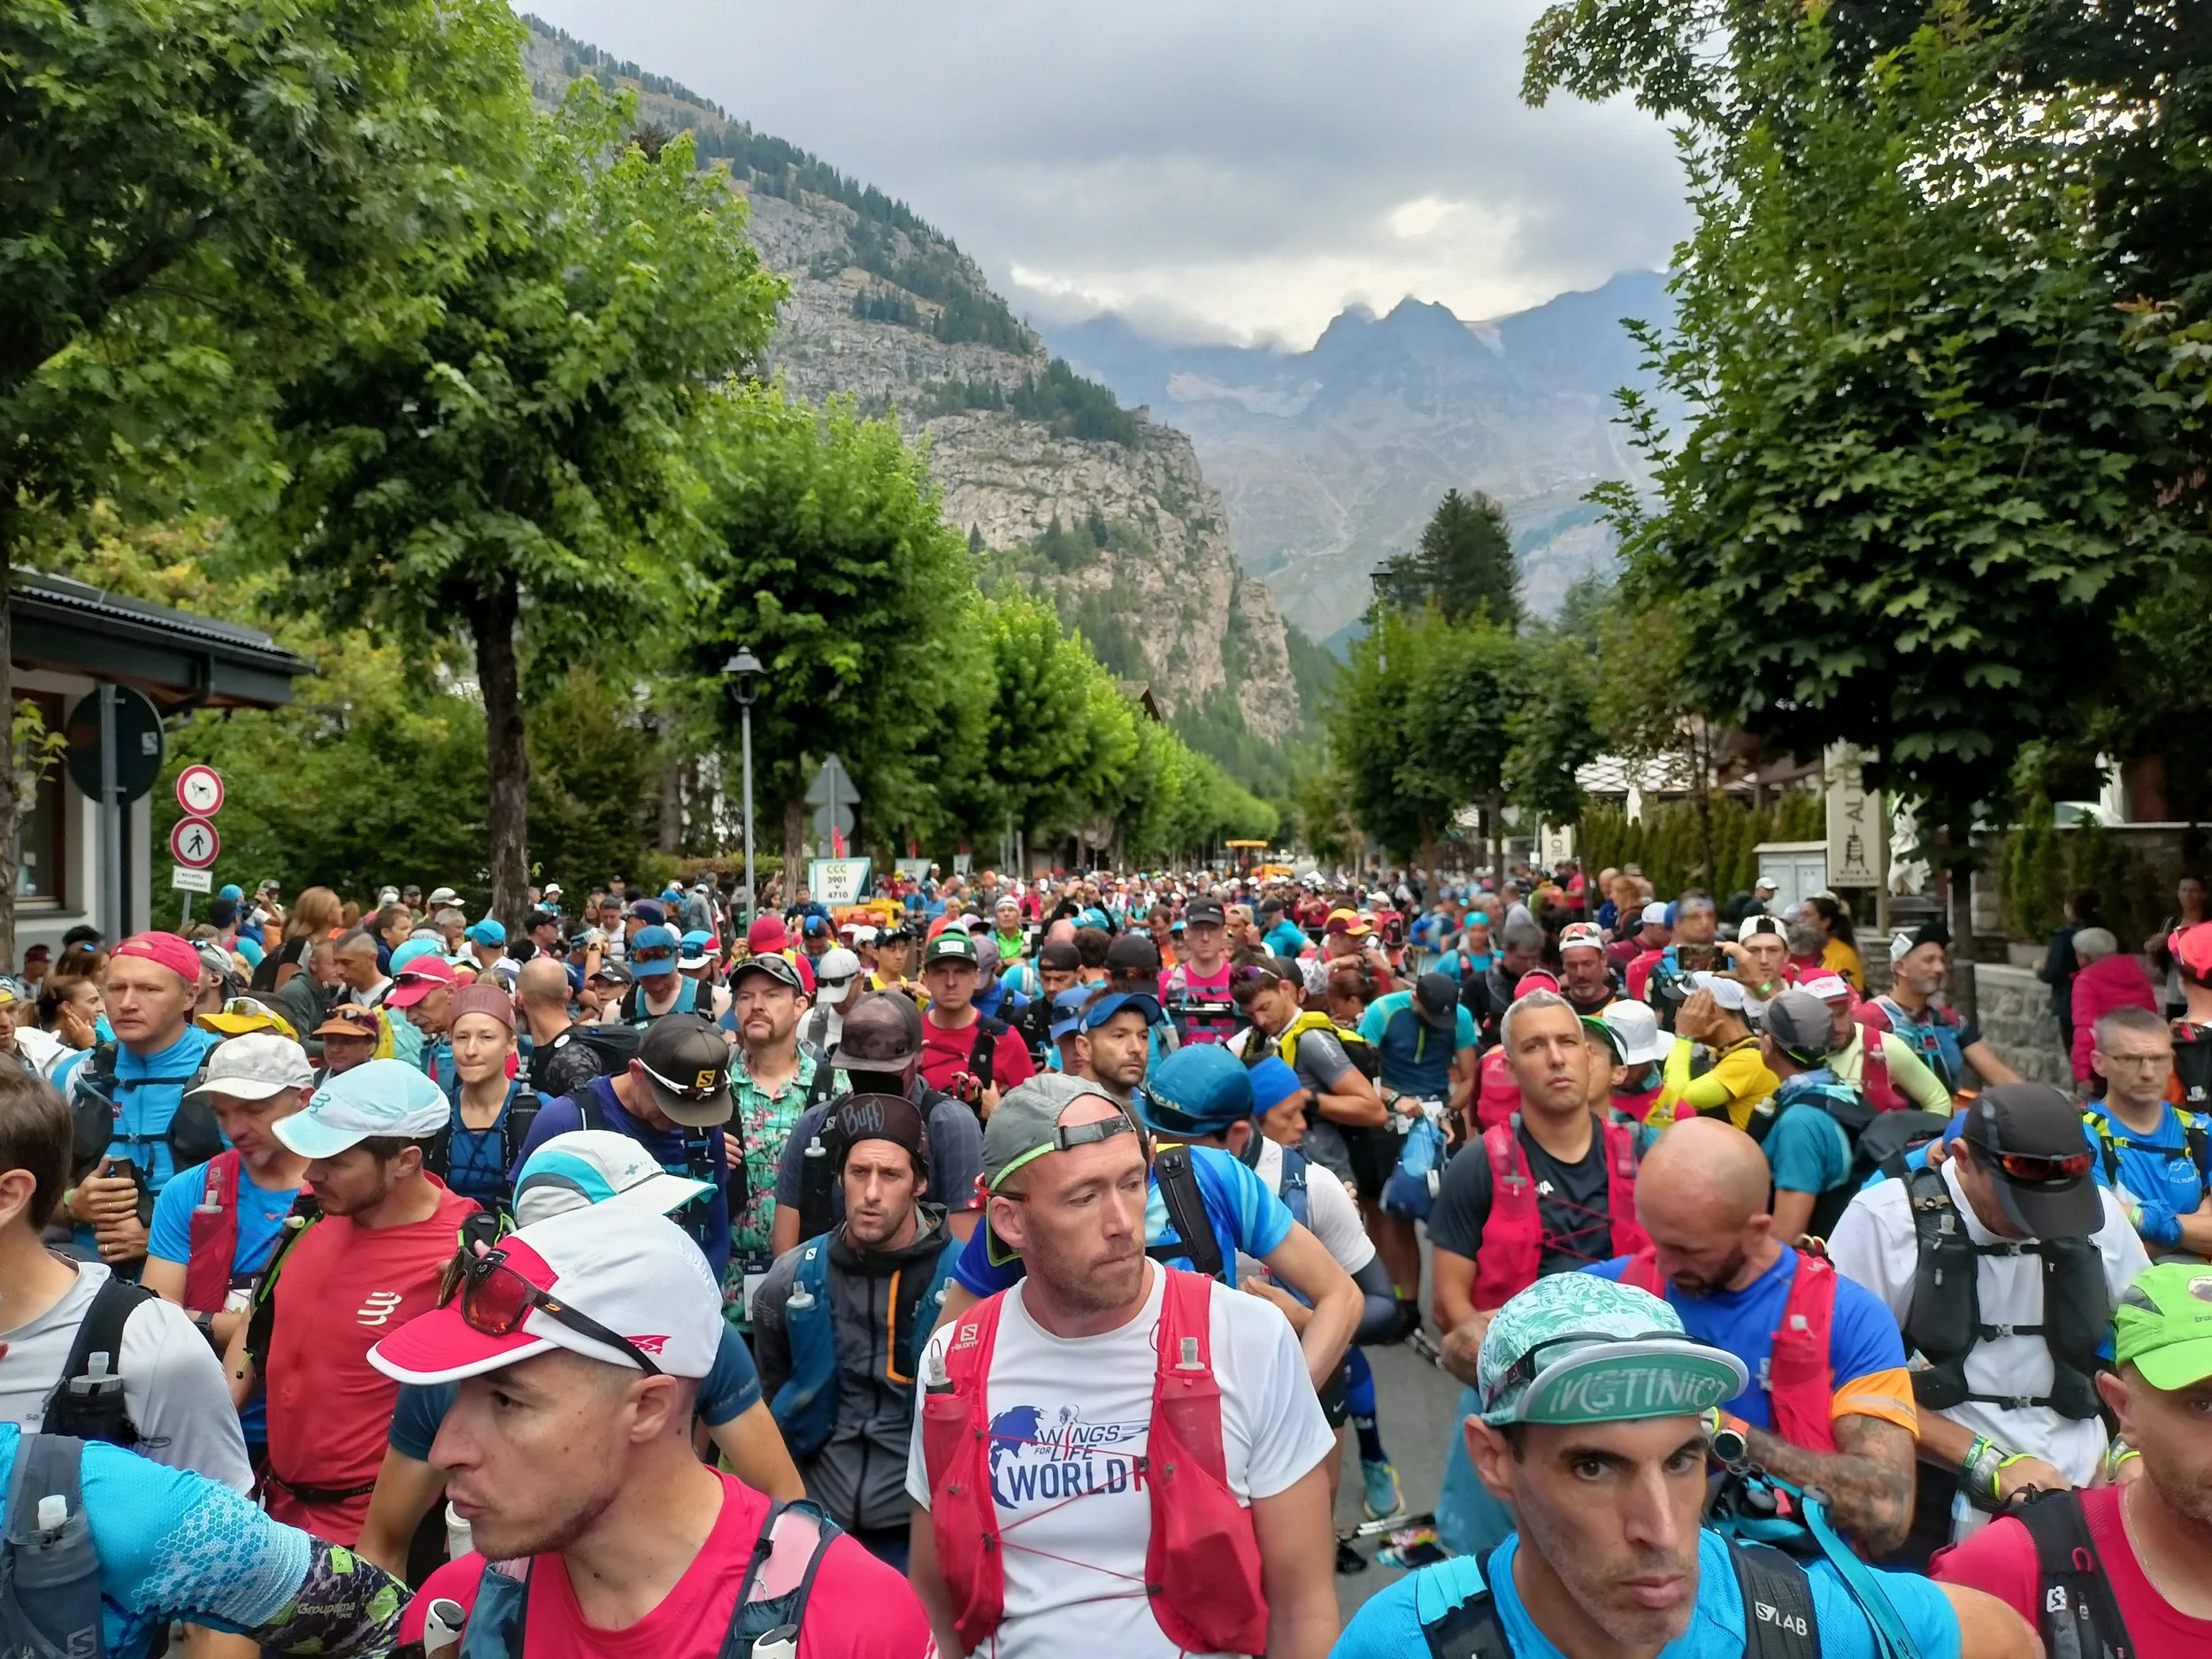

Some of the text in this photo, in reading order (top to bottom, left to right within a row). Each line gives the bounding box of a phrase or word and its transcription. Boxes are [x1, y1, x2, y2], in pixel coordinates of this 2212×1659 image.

[826, 864, 847, 874] CCC
[1050, 1444, 1097, 1462] LIFE
[1007, 1459, 1127, 1502] WORLD
